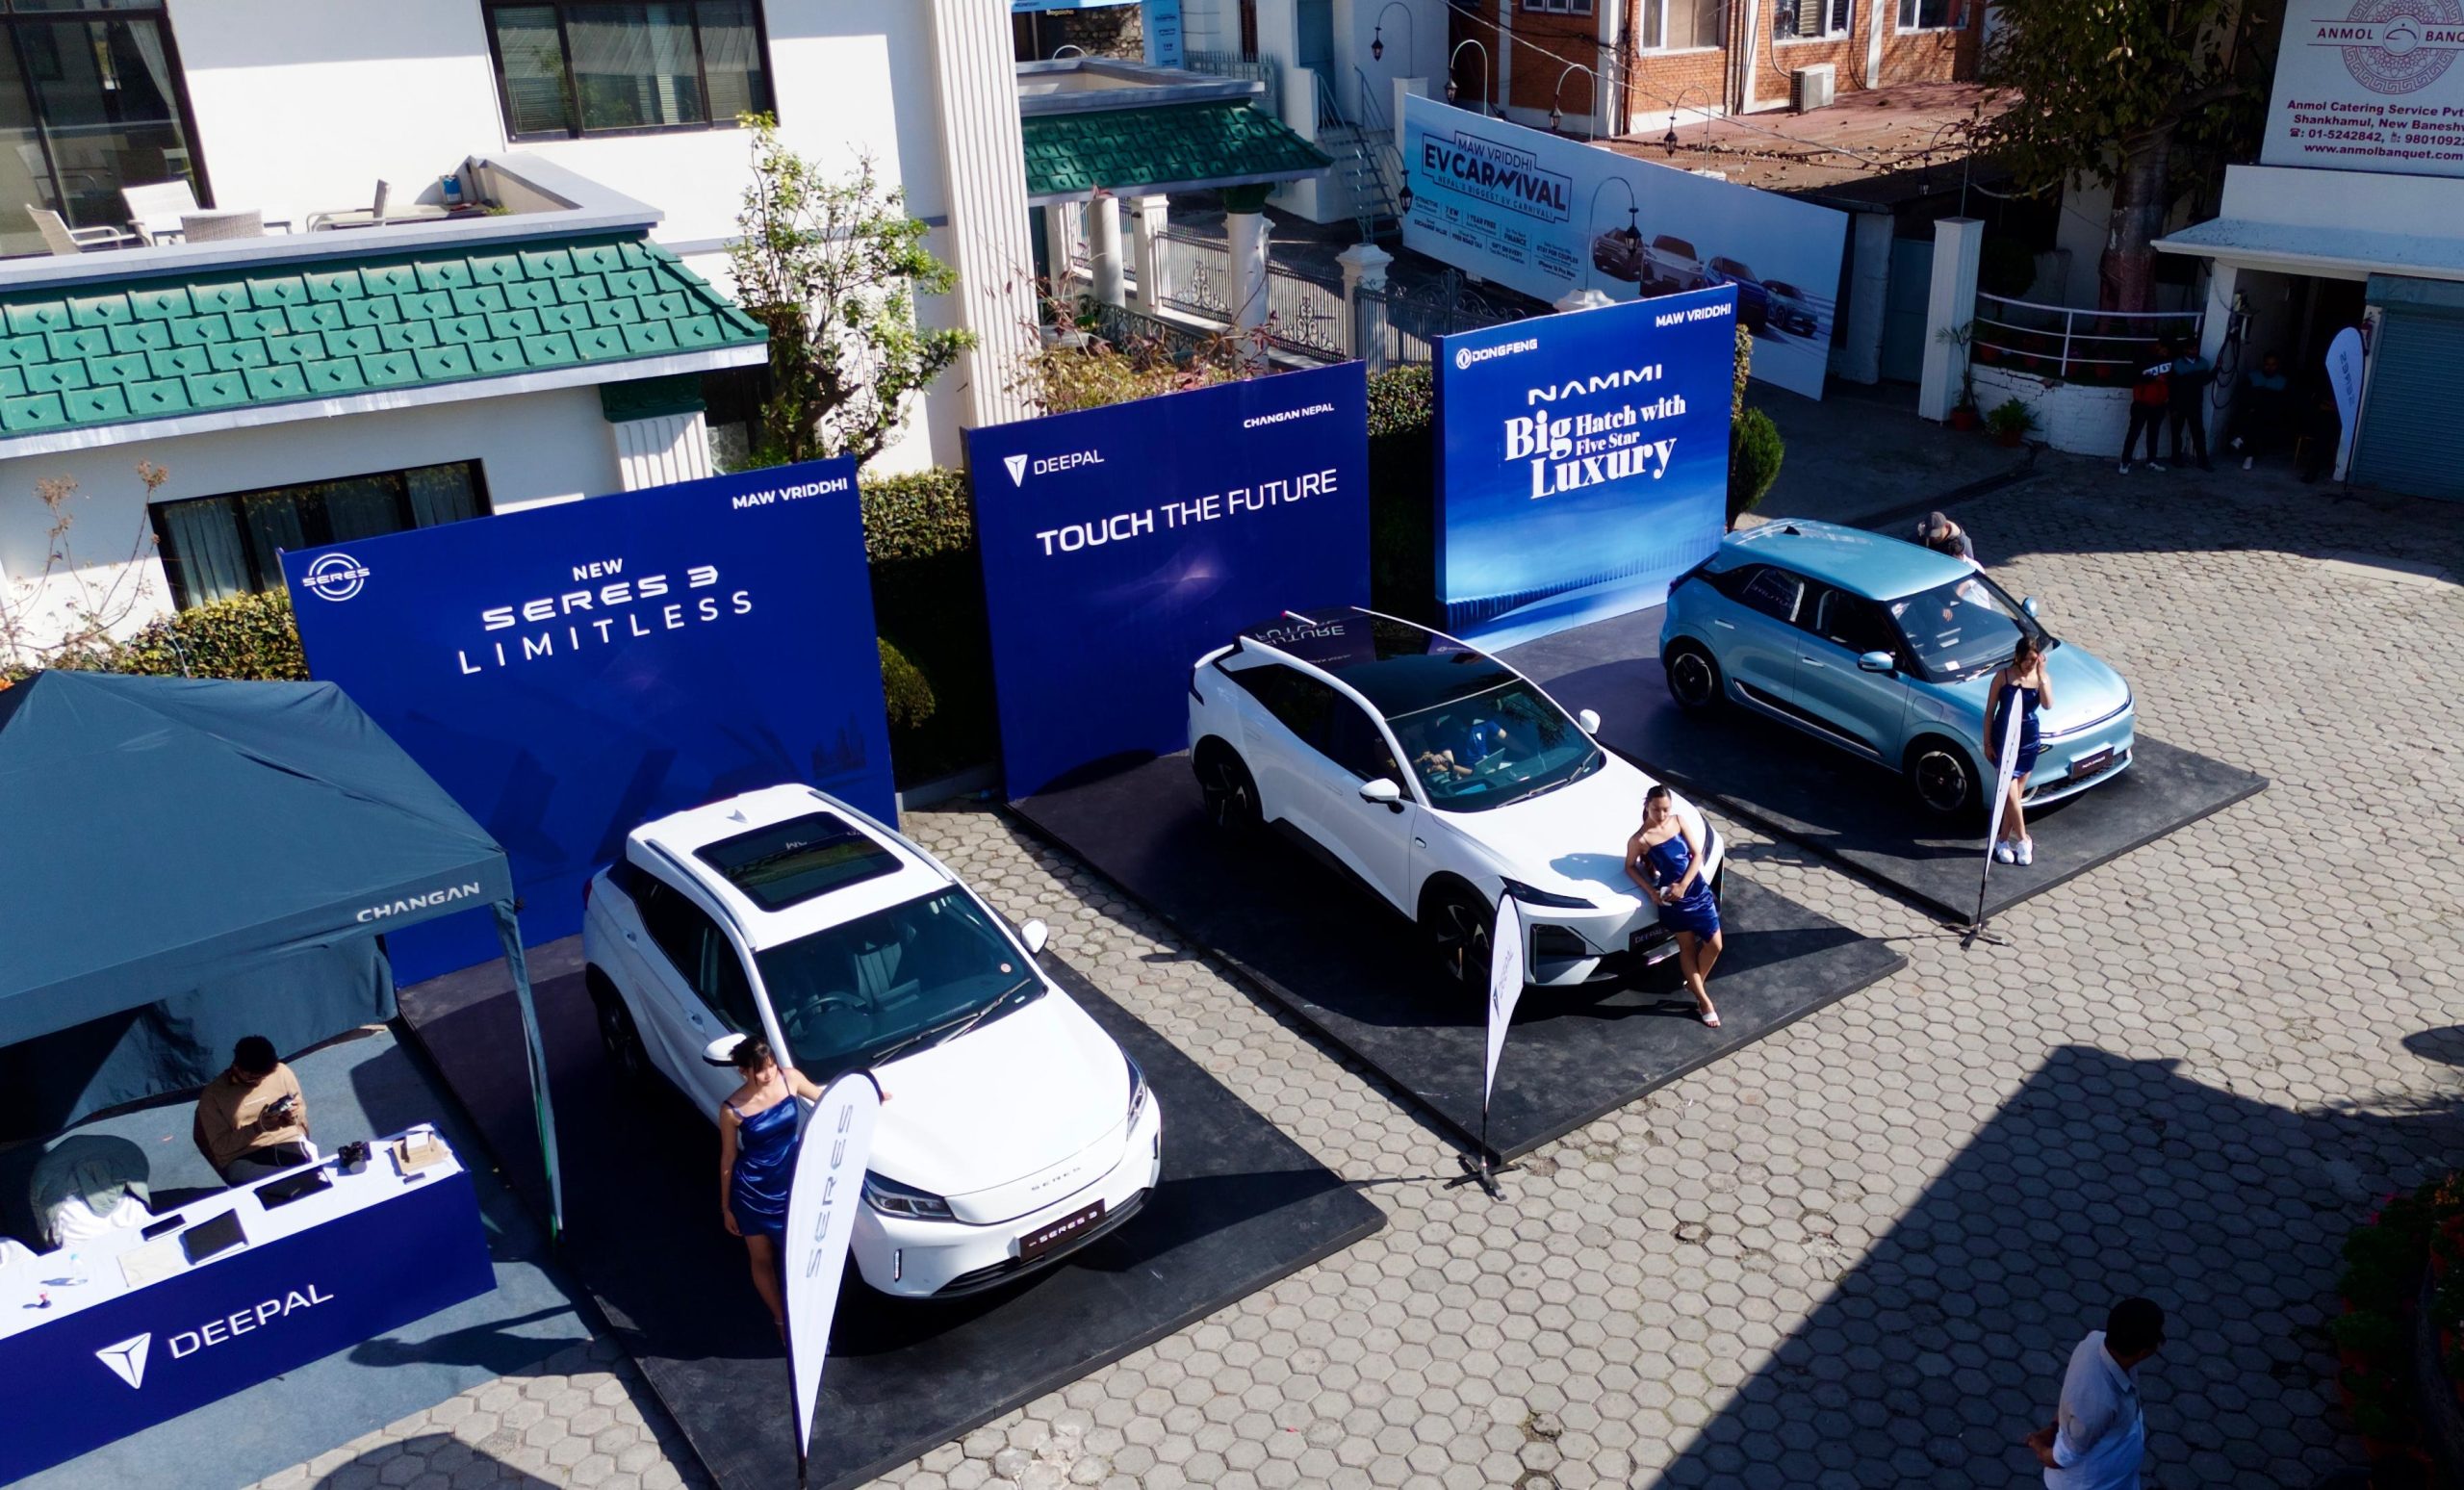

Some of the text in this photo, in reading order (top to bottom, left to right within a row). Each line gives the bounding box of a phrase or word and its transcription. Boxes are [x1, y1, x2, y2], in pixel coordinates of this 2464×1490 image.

[2317, 28, 2374, 40] ANMOL
[2287, 99, 2326, 112] Anmol
[2330, 102, 2384, 116] Catering
[2388, 104, 2438, 116] Service
[2294, 115, 2374, 129] Shankhamul,
[2378, 118, 2407, 129] New
[1457, 138, 1533, 172] MAW VRIDDHI
[2304, 144, 2463, 161] www.anmolbanquet.com
[1437, 174, 1466, 192] NEPAL'S
[1468, 184, 1500, 202] BIGGEST
[1501, 195, 1511, 206] EV
[1656, 303, 1732, 328] MAW VRIDDHI
[1472, 339, 1538, 363] DONGFENG
[1527, 363, 1663, 406] NAMMI
[1243, 402, 1334, 429] CHANGAN NEPAL
[1503, 394, 1686, 462] Big Hatch with
[1576, 430, 1640, 457] Five Star
[1033, 450, 1105, 475] DEEPAL
[1530, 436, 1678, 501] Luxury
[732, 477, 849, 510] MAW VRIDDHI
[1037, 469, 1338, 556] TOUCH THE FUTURE
[301, 566, 371, 588] SERES
[573, 558, 624, 581] NEW
[482, 565, 720, 631] SERES 3
[457, 590, 754, 676] LIMITLESS
[356, 882, 480, 924] CHANGAN
[805, 1103, 853, 1279] SERES
[1040, 1217, 1086, 1244] SERES
[167, 1283, 334, 1359] DEEPAL
